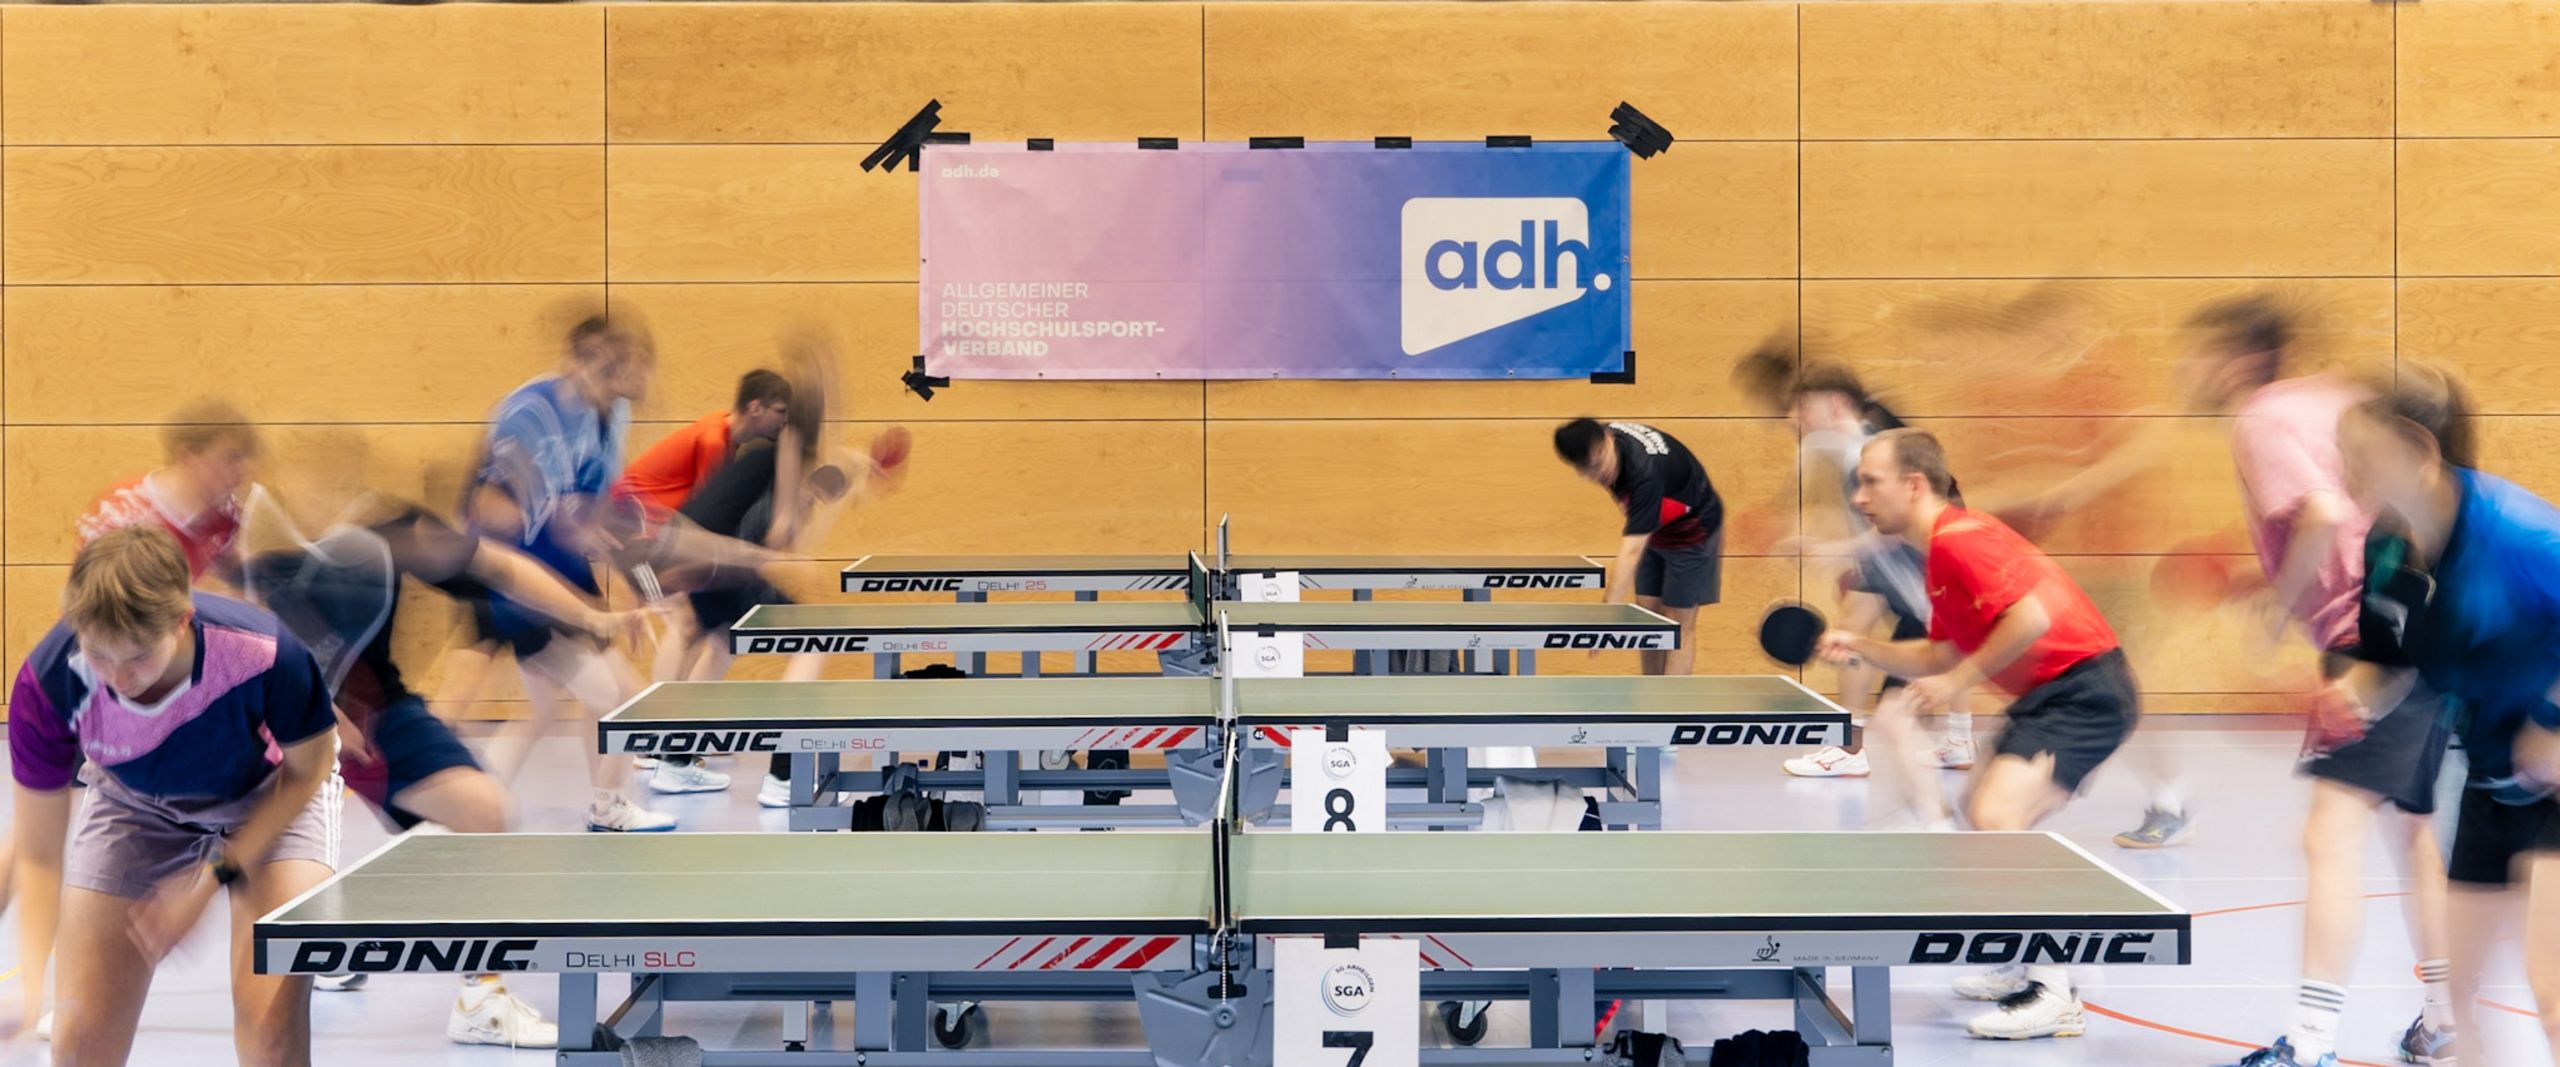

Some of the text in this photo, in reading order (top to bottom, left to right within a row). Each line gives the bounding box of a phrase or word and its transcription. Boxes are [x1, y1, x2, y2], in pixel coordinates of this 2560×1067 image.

[941, 165, 1000, 179] adh.de
[1424, 219, 1612, 292] adh.
[941, 282, 1089, 298] ALLGEMEINER
[941, 302, 1070, 318] DEUTSCHER
[941, 321, 1166, 337] HOCHSCHULSPORT-
[943, 340, 1049, 357] VERBAND
[861, 578, 964, 592] DONIC
[1024, 580, 1047, 591] 25
[1482, 575, 1586, 588] DONIC
[748, 636, 869, 653] DONIC
[920, 640, 949, 650] SLC
[1543, 633, 1664, 650] DONIC
[623, 731, 784, 753] DONIC
[1669, 724, 1830, 746] DONIC
[850, 737, 886, 750] SLC
[1330, 760, 1351, 768] SGA
[1323, 787, 1357, 832] 8
[290, 939, 539, 973] DONIC
[1908, 932, 2156, 964] DONIC
[566, 951, 697, 969] DELHI SLC
[1334, 985, 1365, 997] SGA
